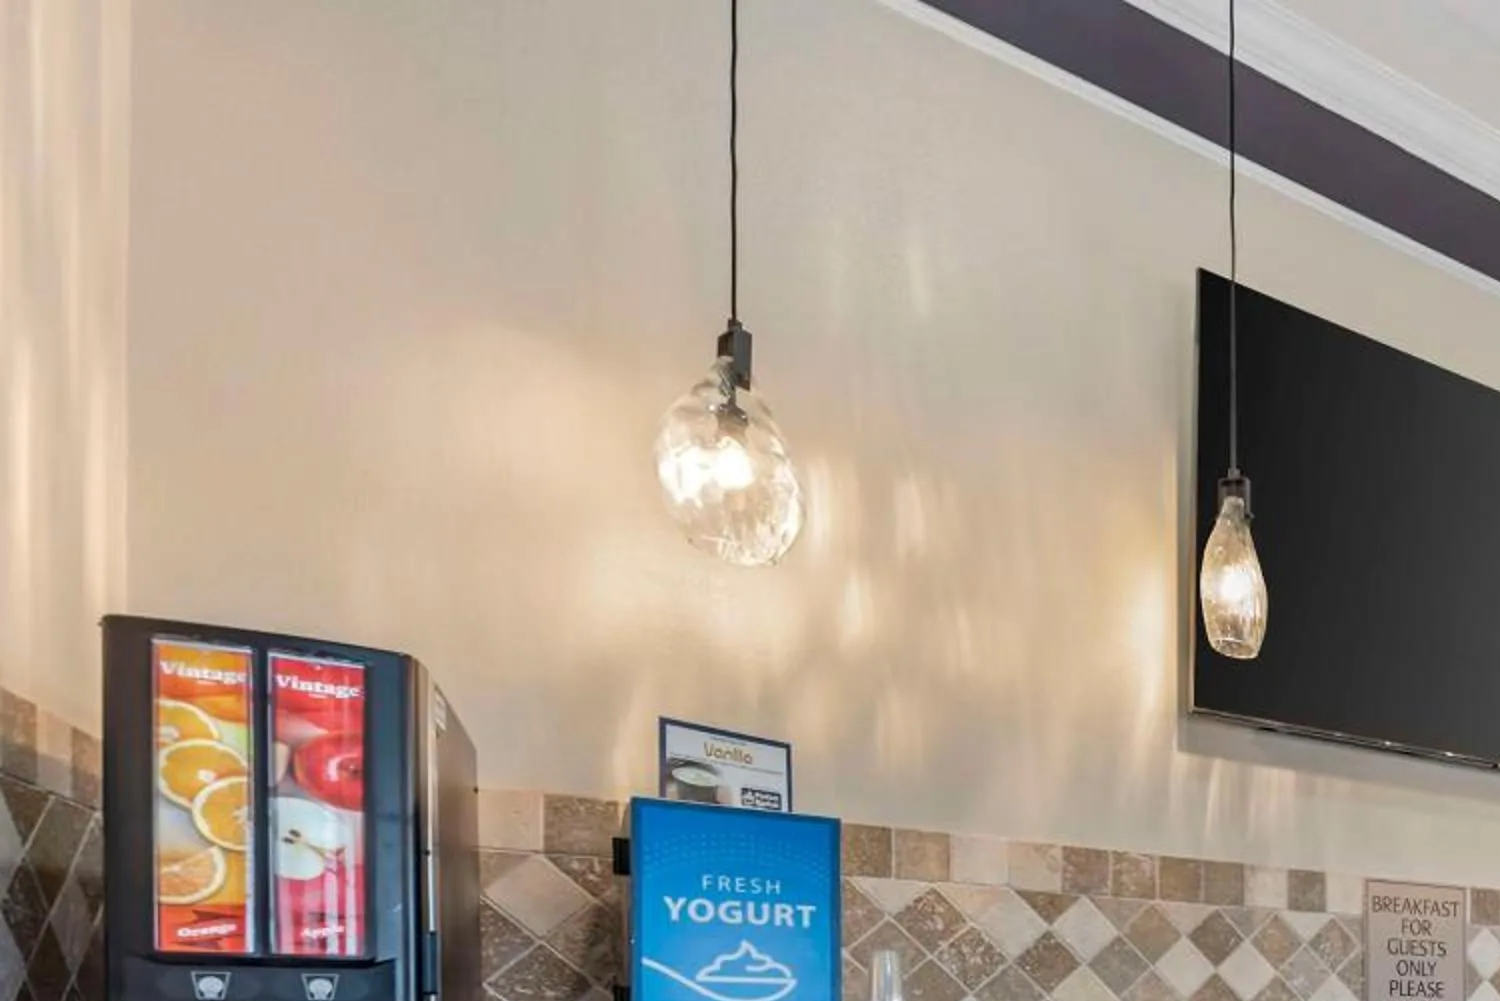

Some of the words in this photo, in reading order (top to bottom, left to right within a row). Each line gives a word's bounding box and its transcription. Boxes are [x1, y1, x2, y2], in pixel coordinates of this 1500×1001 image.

[160, 661, 247, 685] Vintage
[275, 674, 362, 699] Vintage
[701, 874, 781, 895] FRESH
[663, 895, 817, 928] YOGURT
[1371, 895, 1460, 918] BREAKFAST
[1400, 918, 1432, 937] FOR
[1386, 938, 1448, 957] GUESTS
[1395, 960, 1437, 978] ONLY
[1388, 979, 1445, 998] PLEASE
